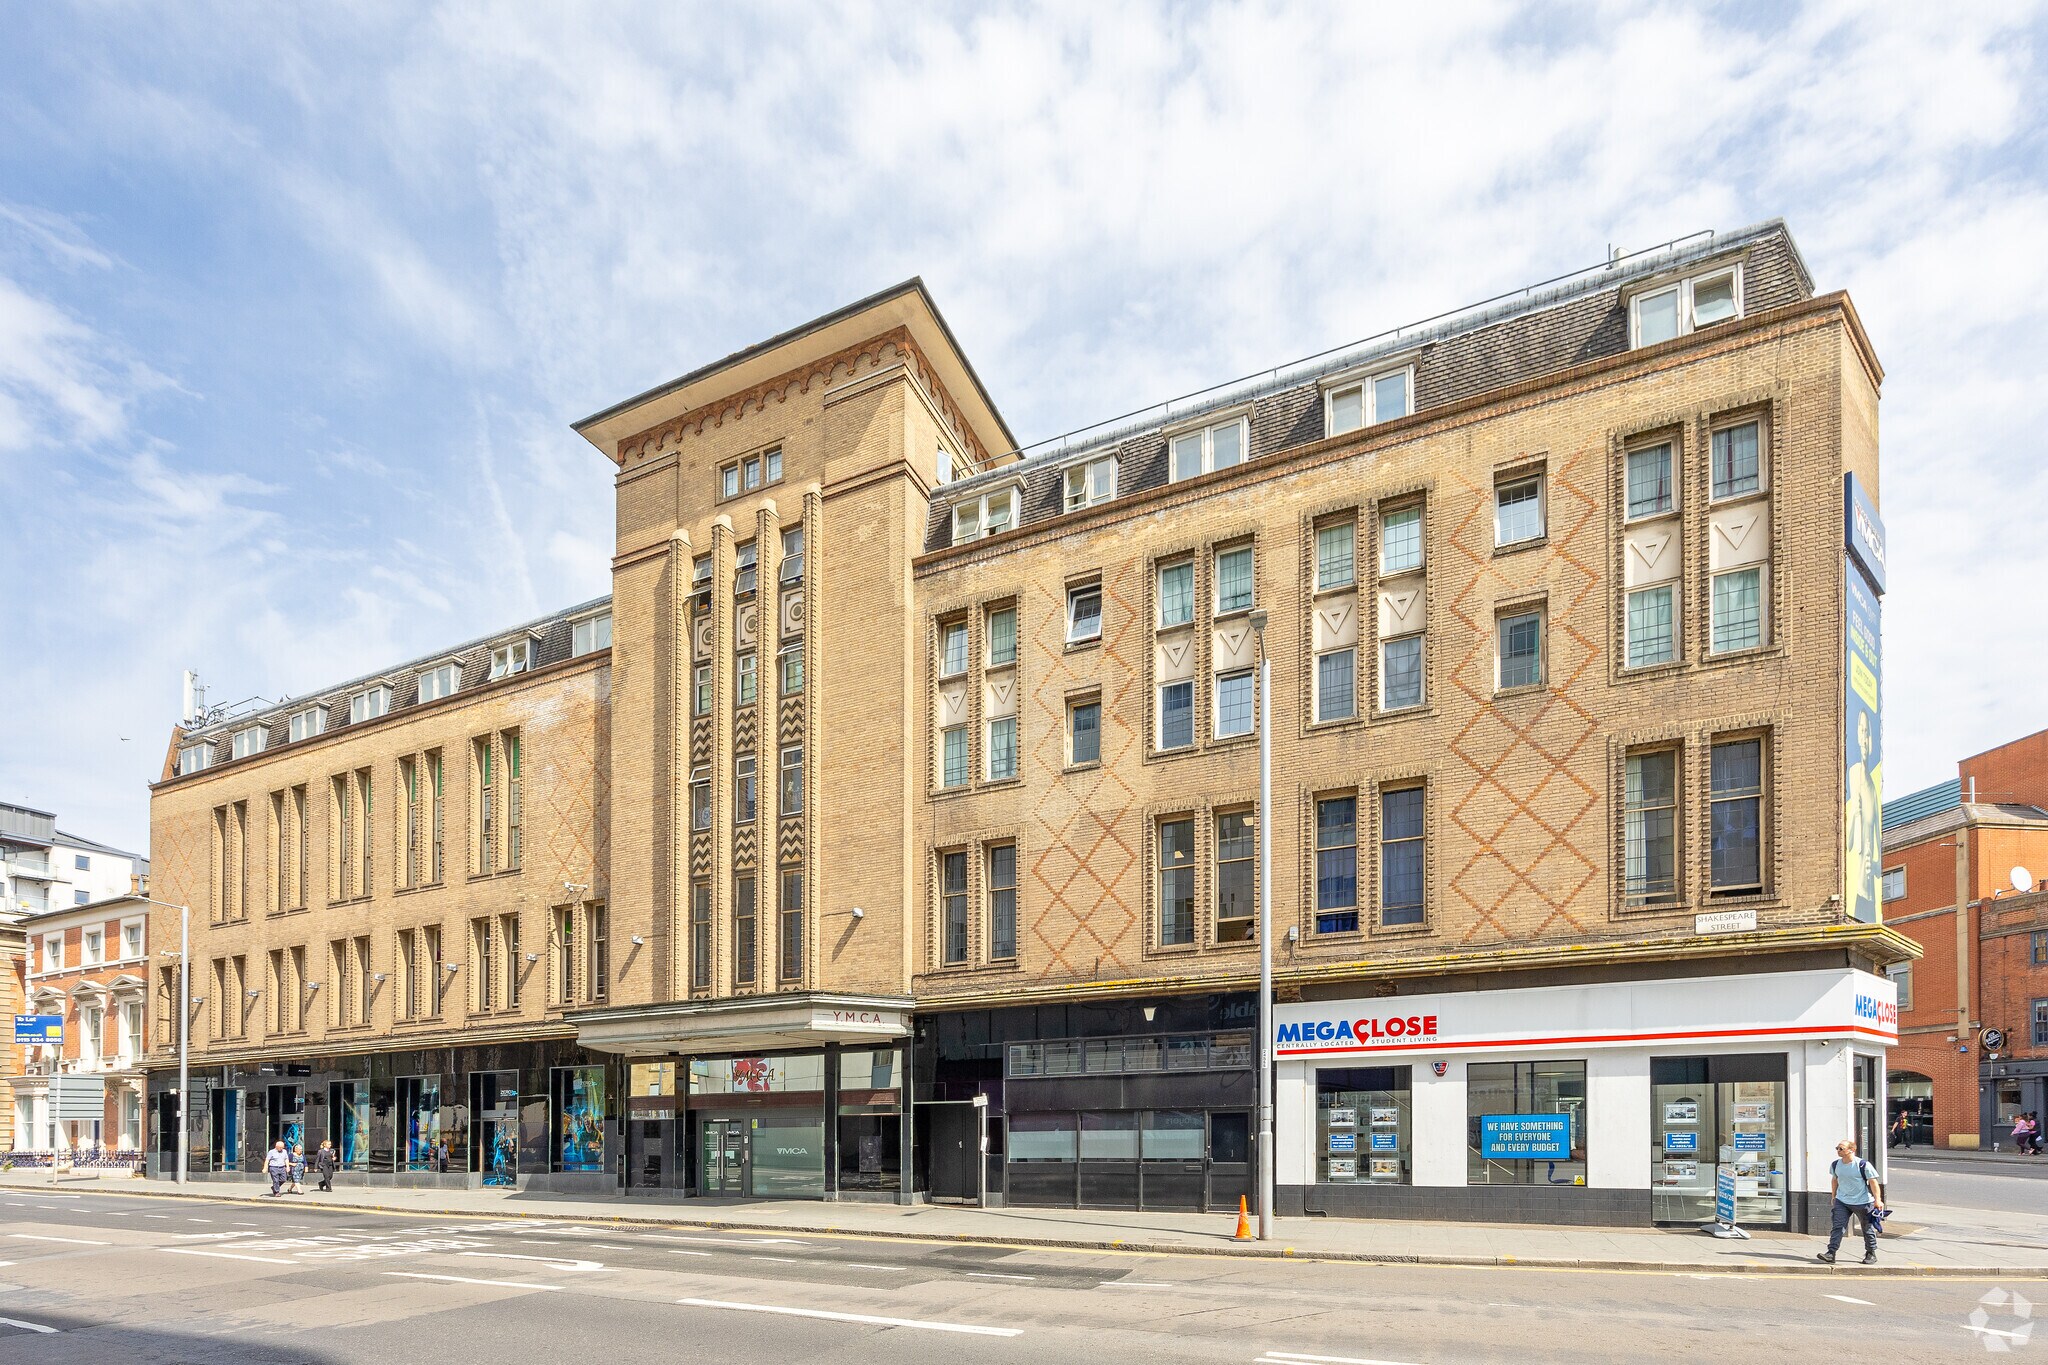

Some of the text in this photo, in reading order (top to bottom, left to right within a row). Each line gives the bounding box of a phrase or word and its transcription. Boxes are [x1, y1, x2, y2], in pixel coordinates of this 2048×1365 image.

[1854, 503, 1886, 573] YMCA
[1697, 912, 1755, 923] SHAKESPEARE
[1710, 922, 1741, 931] STREET
[1855, 993, 1896, 1028] MEGACLOSE
[1277, 1016, 1437, 1045] MEGACLOSE
[1371, 1037, 1407, 1045] STUDENT
[1487, 1121, 1563, 1131] WE HAVE SOMETHING
[1499, 1132, 1551, 1141] FOR EVERYONE
[777, 1147, 808, 1155] YMCA
[1491, 1142, 1560, 1152] AND EVERY BUDGET
